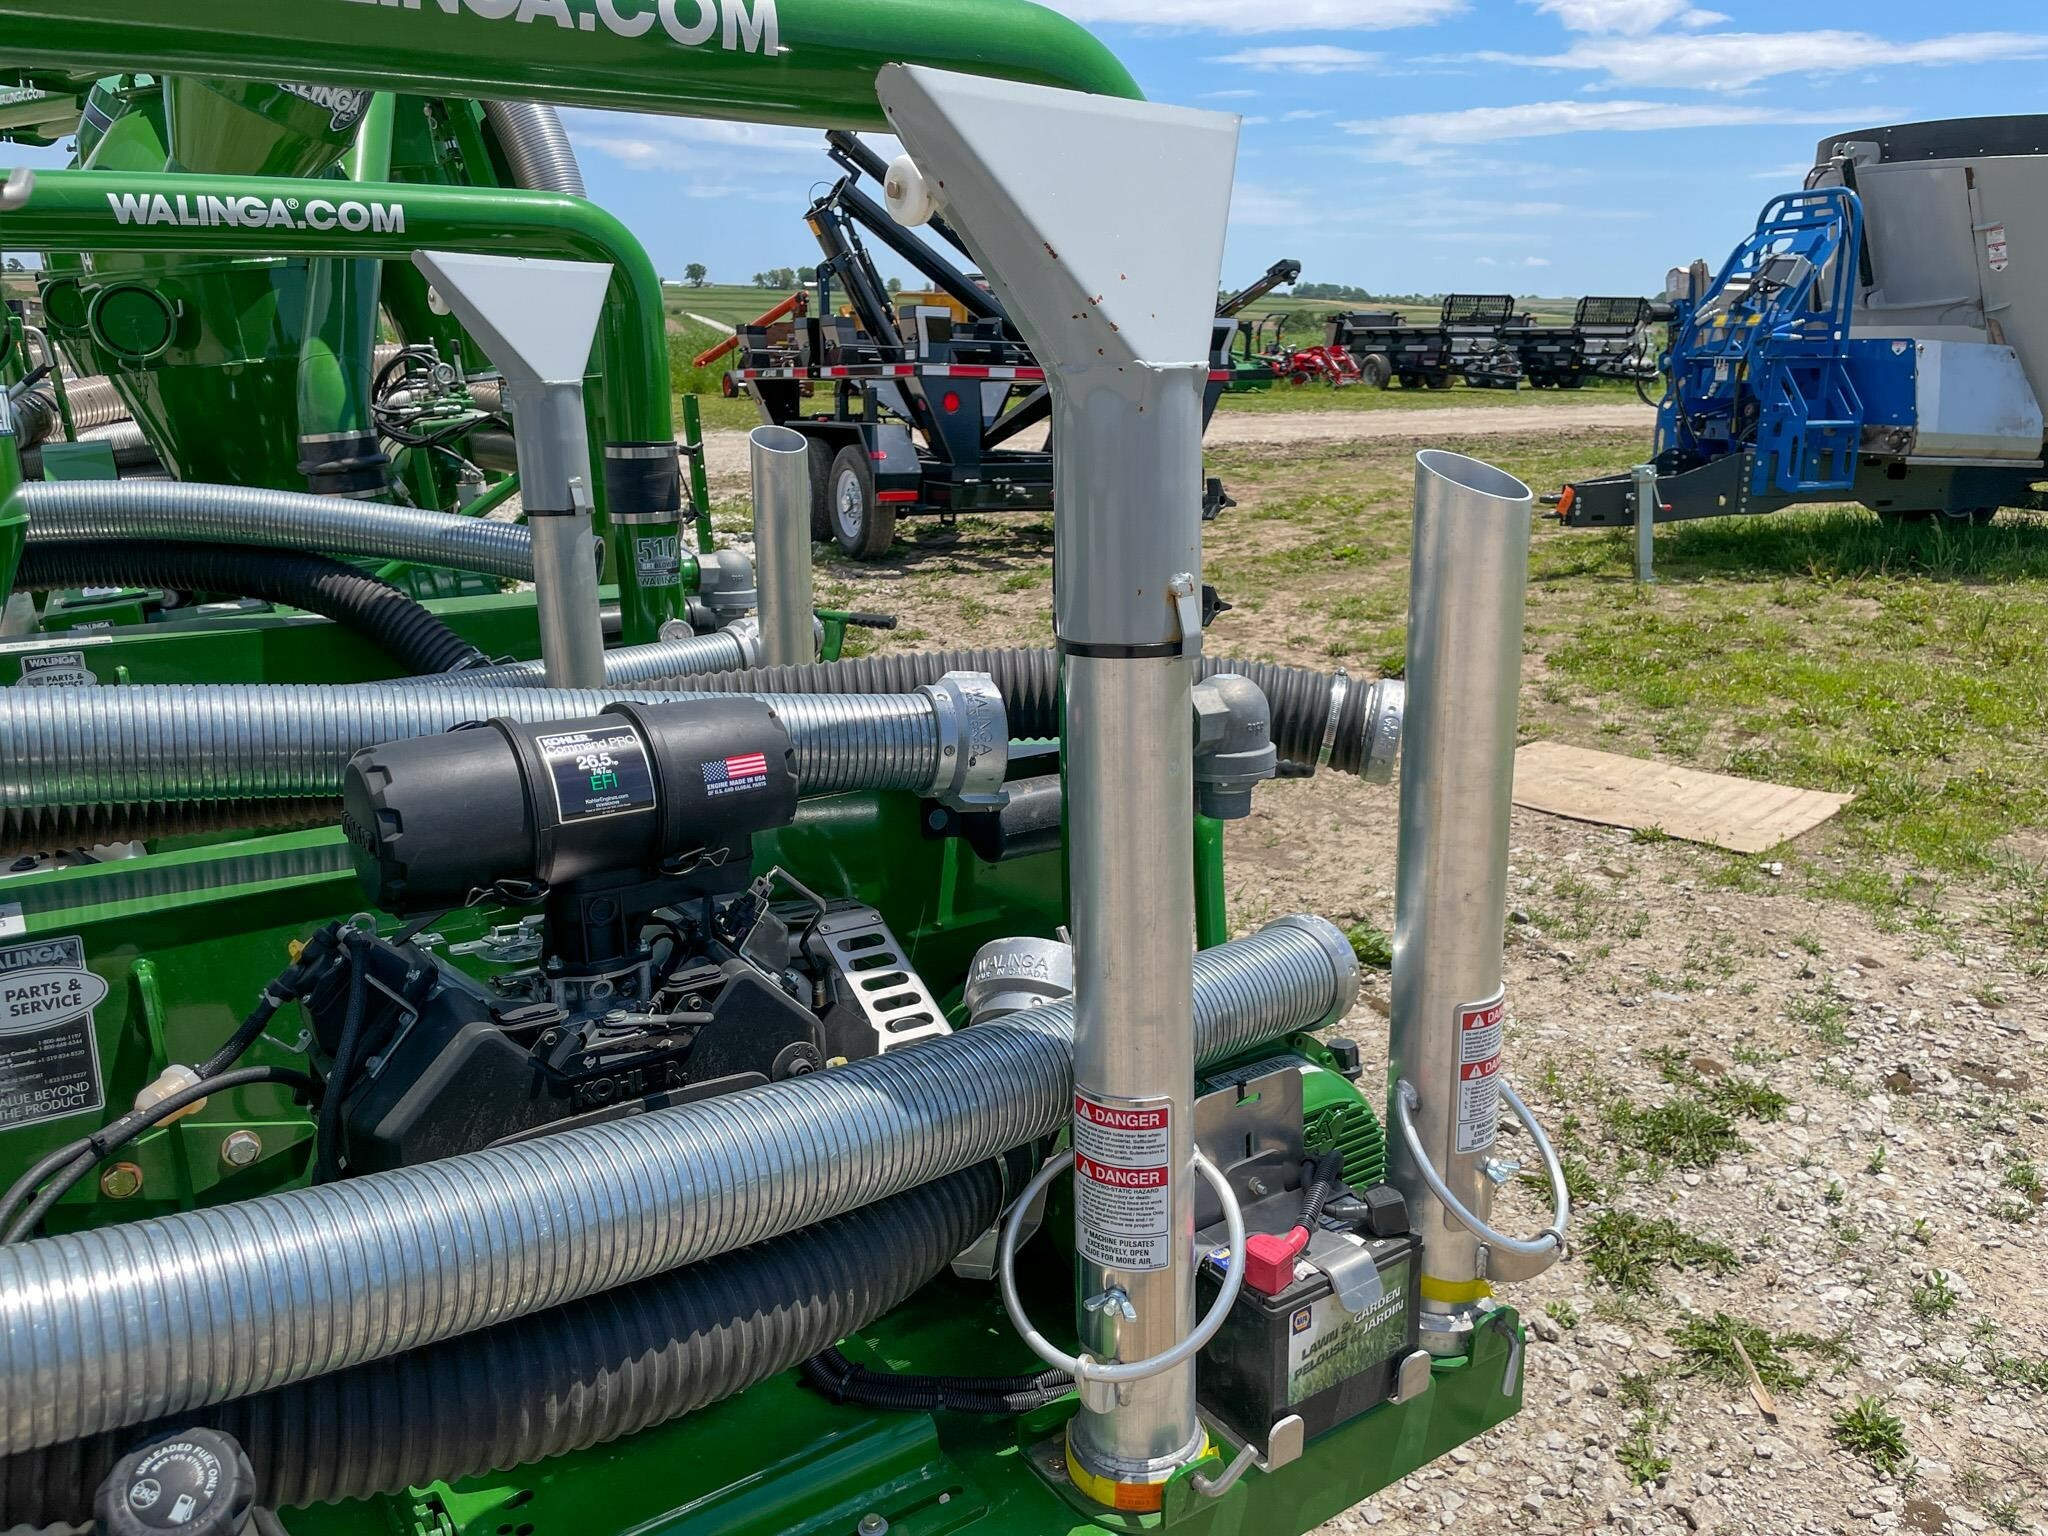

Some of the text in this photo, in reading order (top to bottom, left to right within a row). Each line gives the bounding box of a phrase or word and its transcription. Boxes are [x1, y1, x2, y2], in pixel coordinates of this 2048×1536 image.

[29, 656, 77, 668] WALINGA
[46, 673, 74, 684] PARTS
[546, 739, 608, 755] Command
[590, 773, 618, 791] EFI
[706, 781, 728, 790] ENGINE
[729, 778, 746, 786] MADE
[0, 945, 68, 969] LINGA
[978, 953, 1048, 973] WALINGA
[1008, 967, 1048, 981] CANADA
[5, 978, 82, 1002] PARTS &
[10, 993, 82, 1017] SERVICE
[34, 1081, 90, 1101] BEYOND
[26, 1094, 86, 1115] PRODUCT
[1096, 1108, 1160, 1126] DANGER
[1096, 1167, 1160, 1185] DANGER
[1086, 1179, 1132, 1194] ELECTRO-STATIC
[1089, 1230, 1117, 1245] MACHINE
[1085, 1245, 1101, 1258] SLIDE
[1101, 1253, 1114, 1262] FOR
[1088, 1238, 1128, 1256] EXCESSIVELY,
[1302, 1327, 1338, 1360] LAWN
[1354, 1286, 1400, 1323] GARDEN
[1294, 1337, 1348, 1380] PELOUSE
[1363, 1300, 1404, 1335] JARDIN
[136, 1443, 218, 1498] UNLEADED FUEL ONLY
[132, 1484, 160, 1503] E85
